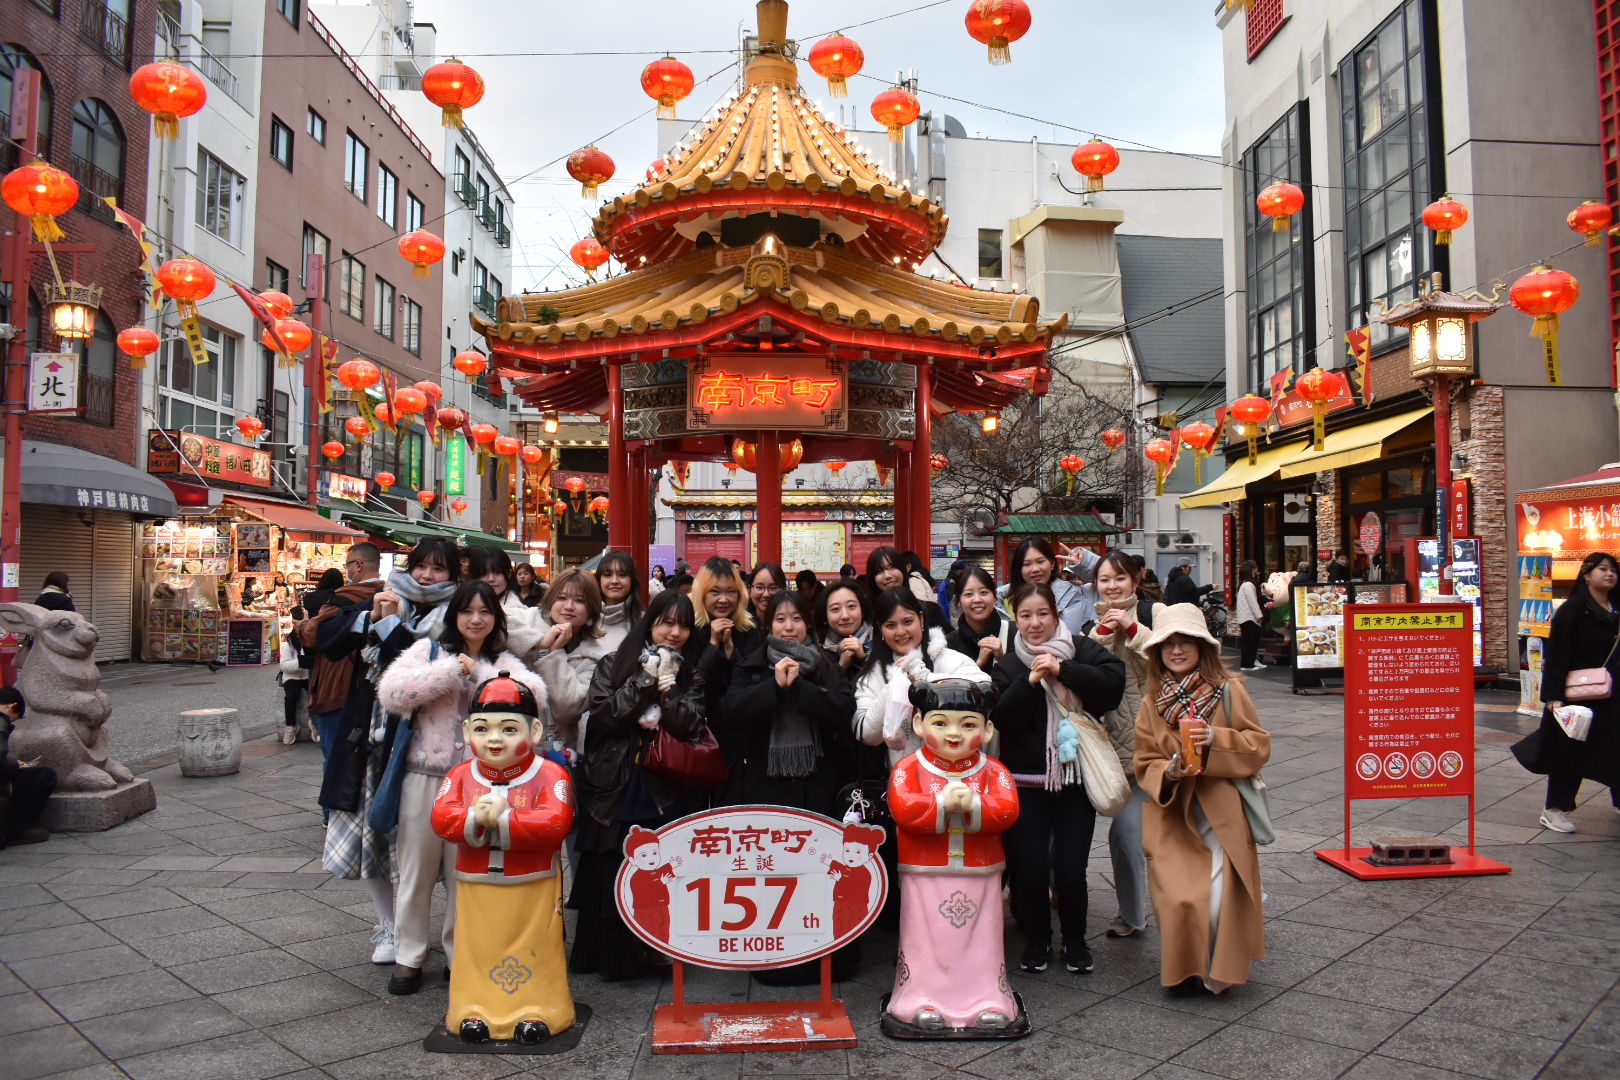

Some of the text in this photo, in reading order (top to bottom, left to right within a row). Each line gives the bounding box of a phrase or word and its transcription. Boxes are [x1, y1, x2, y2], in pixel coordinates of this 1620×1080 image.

[40, 376, 67, 397] 北
[697, 370, 839, 409] 南京町
[43, 400, 62, 408] 山側
[1360, 615, 1457, 627] 南京町内禁止事項
[690, 825, 813, 857] 南京町
[731, 855, 775, 872] 生誕
[685, 876, 820, 932] 157 th
[719, 936, 785, 953] BE KOBE
